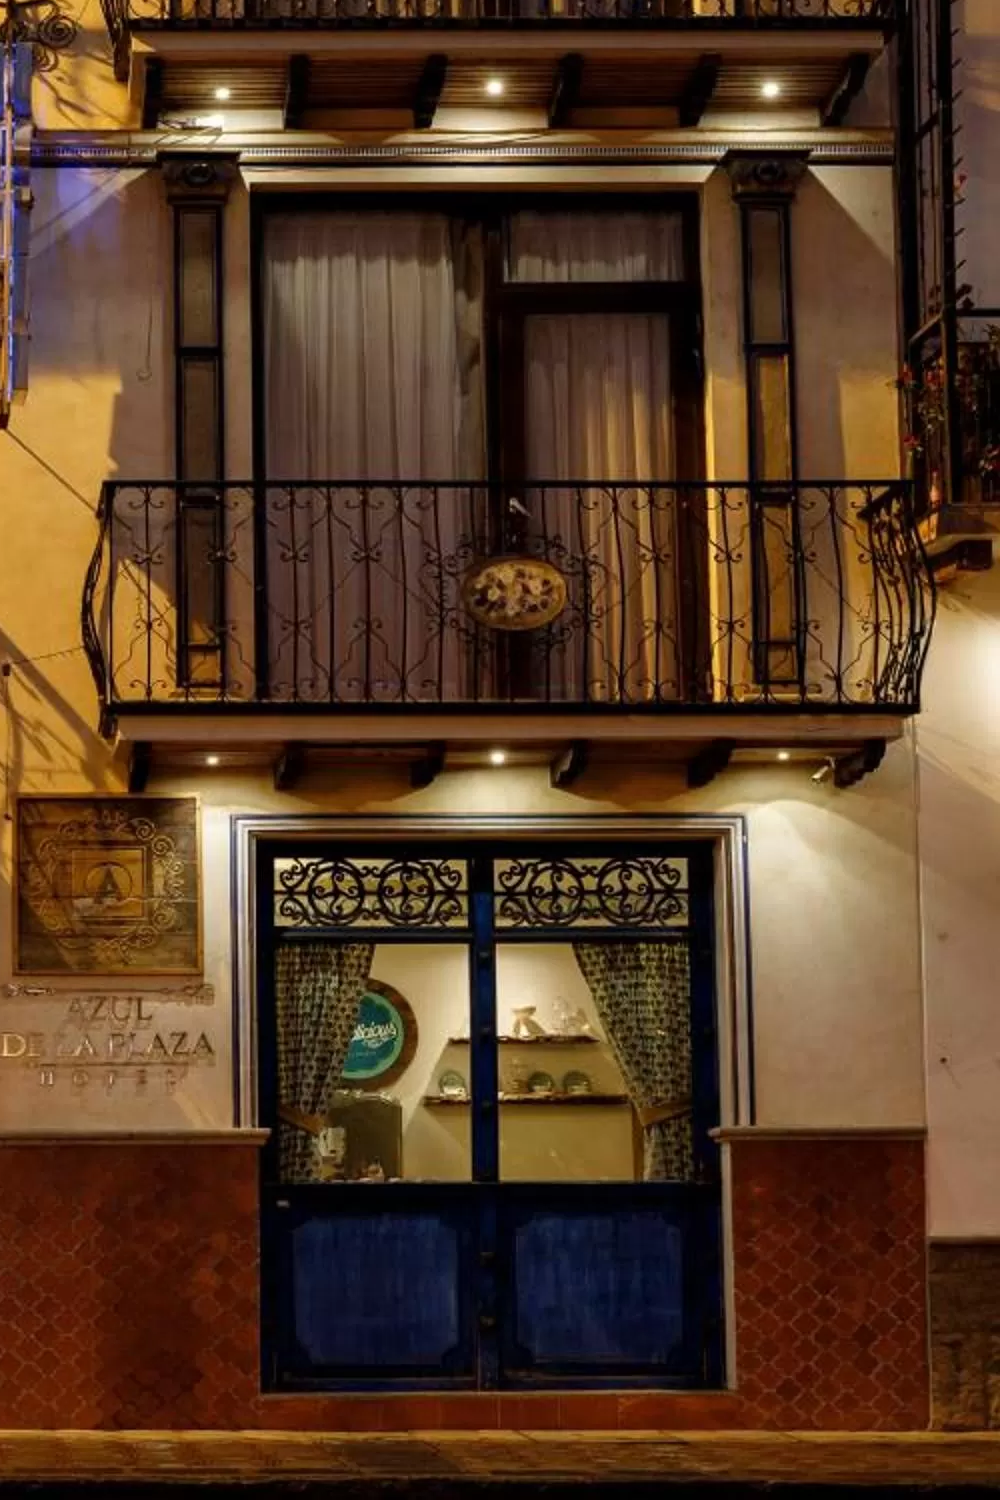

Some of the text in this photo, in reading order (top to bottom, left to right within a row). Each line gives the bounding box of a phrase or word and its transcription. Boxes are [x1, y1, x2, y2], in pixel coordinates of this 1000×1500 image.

[68, 995, 153, 1021] AZUL
[0, 1031, 216, 1057] DE LA PLAZA
